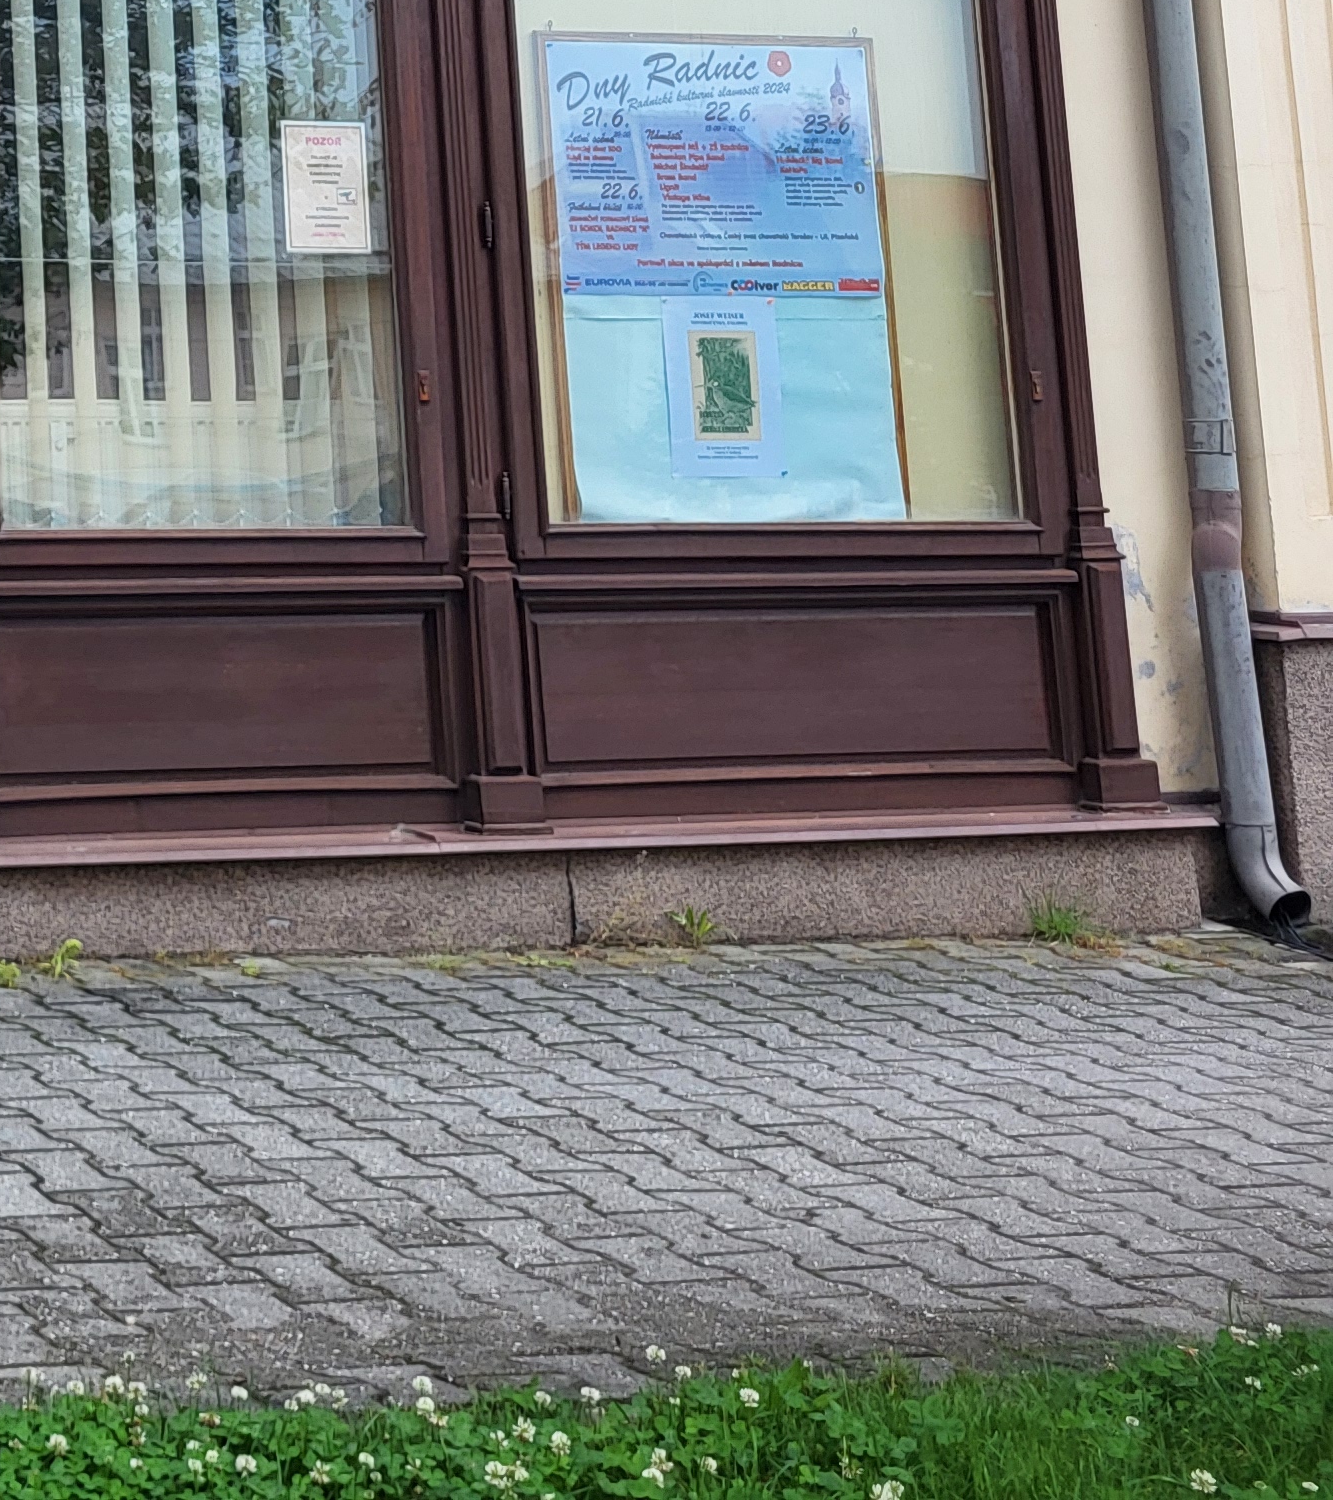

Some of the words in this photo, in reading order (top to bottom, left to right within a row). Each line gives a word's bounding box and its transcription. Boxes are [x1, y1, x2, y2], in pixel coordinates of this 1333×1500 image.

[556, 71, 631, 110] Dny
[643, 49, 759, 91] Radnic
[718, 85, 760, 99] slavnosti
[763, 82, 791, 95] 2024
[305, 136, 342, 147] POZOR
[600, 182, 644, 201] 22.6.
[585, 278, 632, 288] EUROVIA
